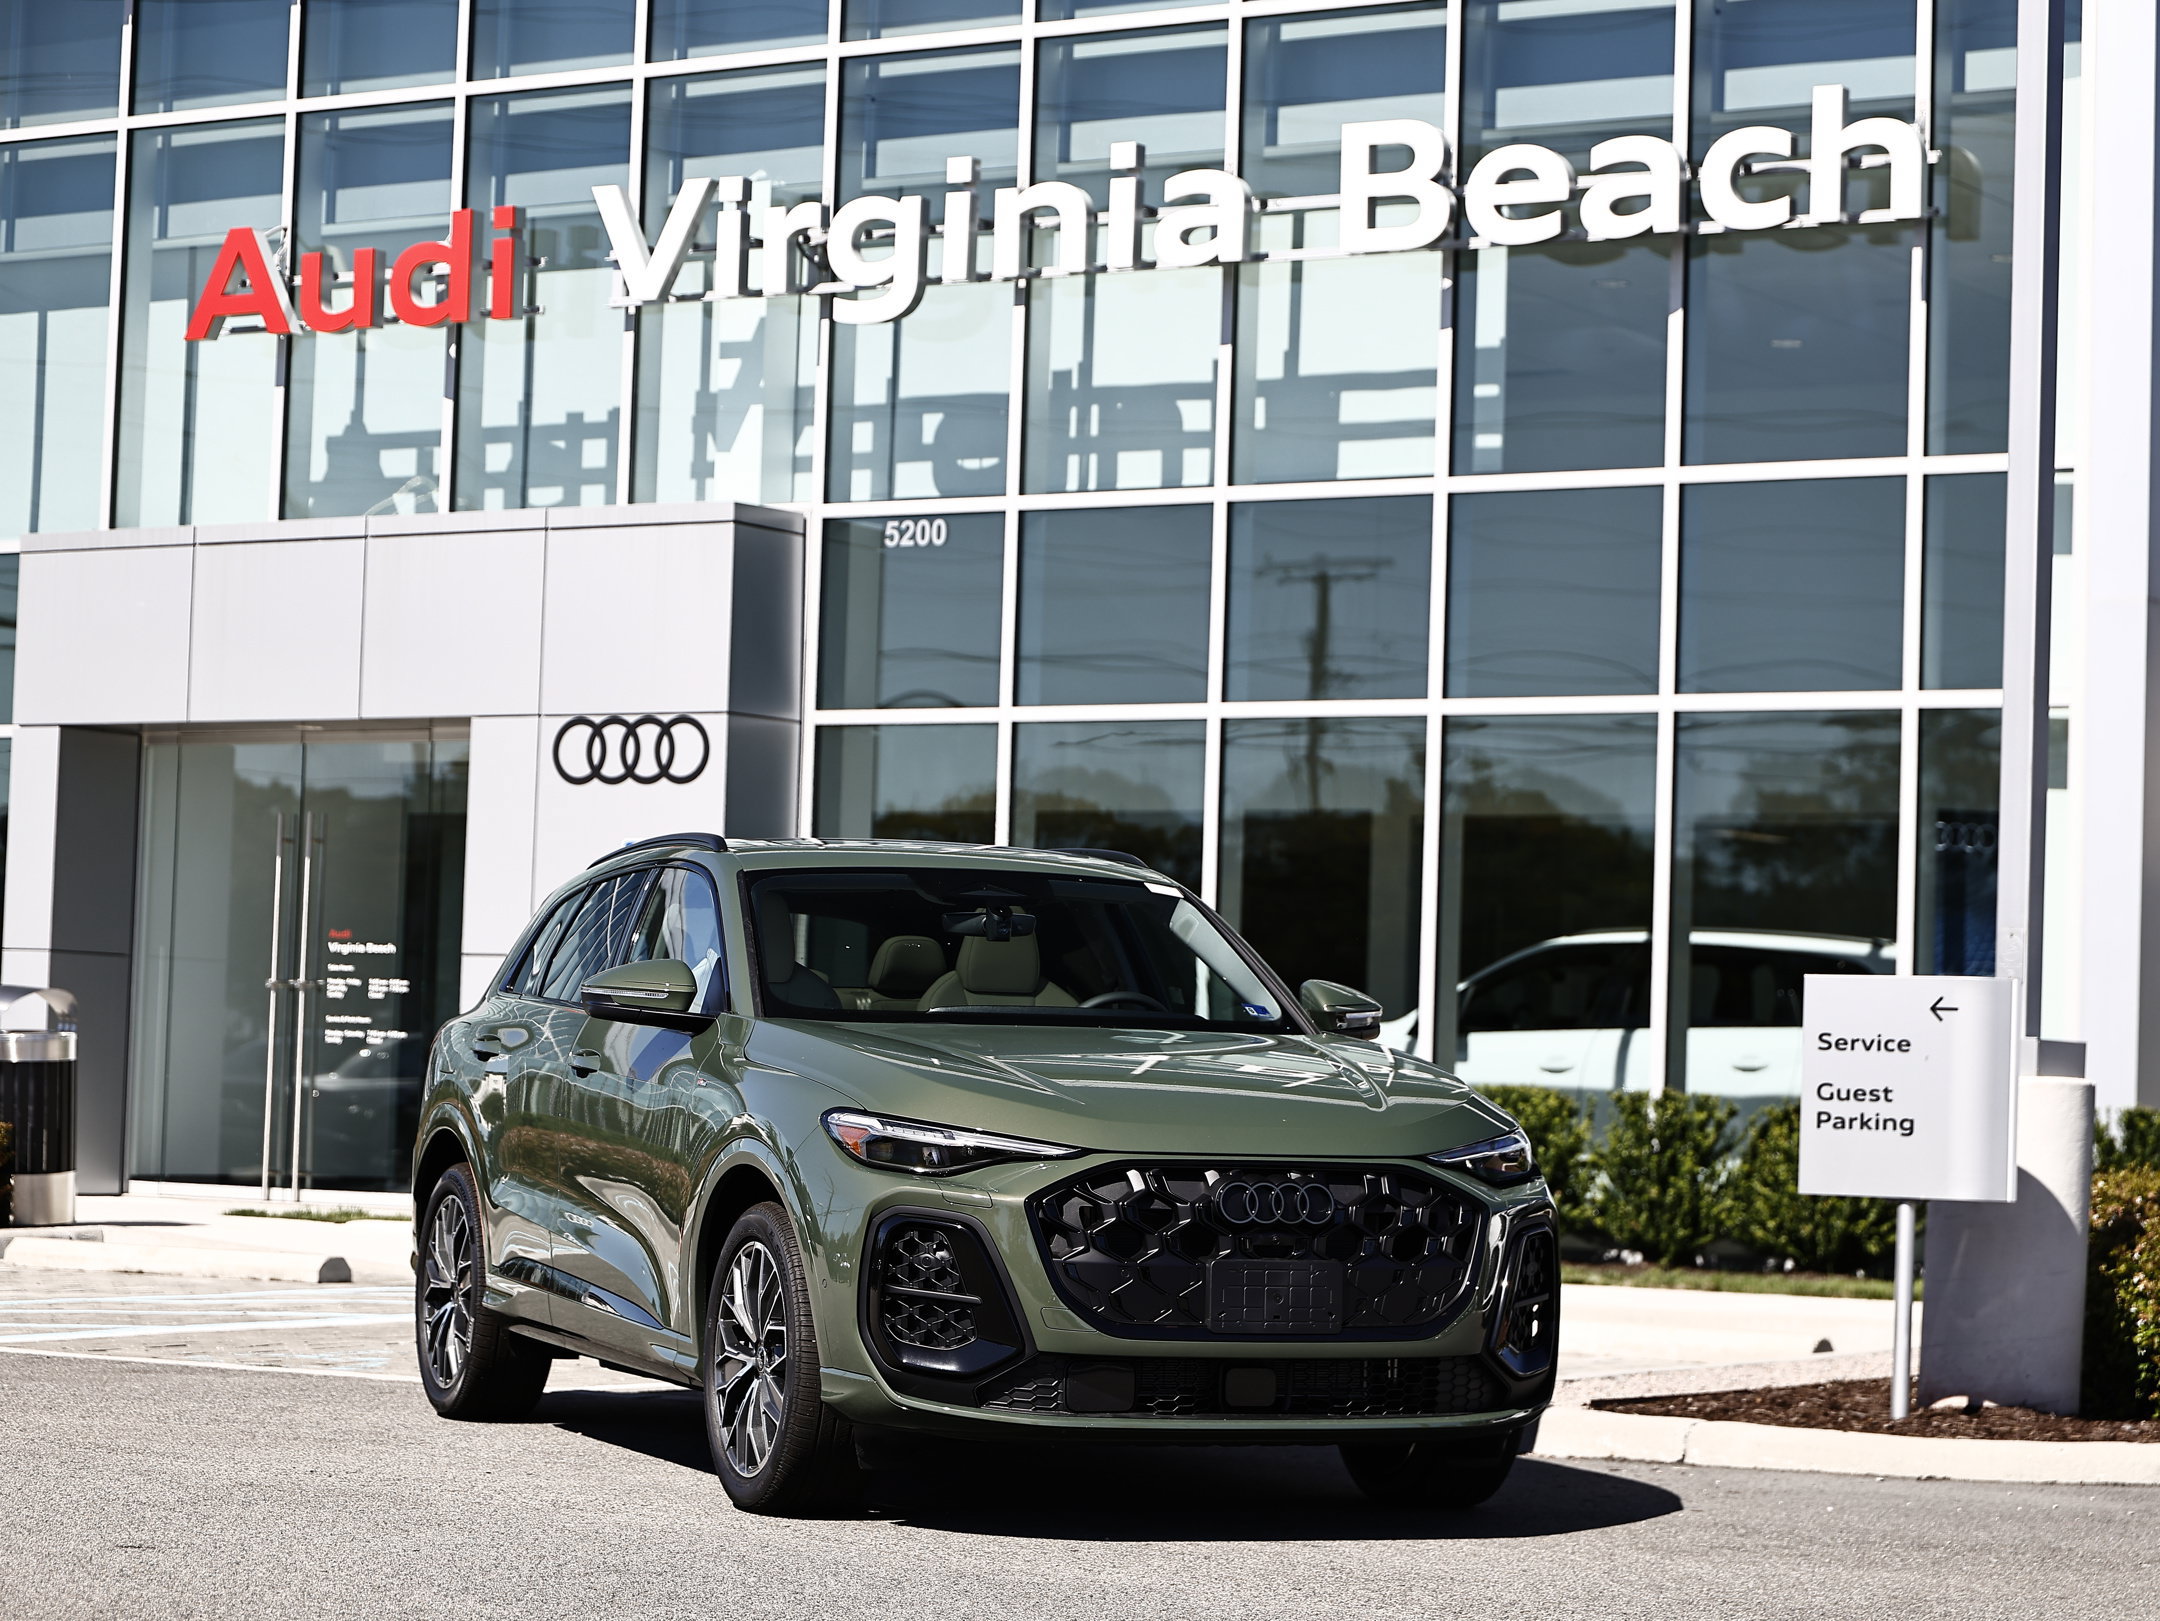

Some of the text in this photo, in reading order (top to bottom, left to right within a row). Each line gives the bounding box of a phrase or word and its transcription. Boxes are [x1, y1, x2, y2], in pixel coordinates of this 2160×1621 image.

[184, 83, 1926, 341] Audi Virginia Beach
[884, 518, 947, 549] 5200
[327, 941, 365, 955] Virginia
[1817, 1032, 1911, 1053] Service
[1816, 1082, 1893, 1103] Guest
[1816, 1110, 1915, 1137] Parking
